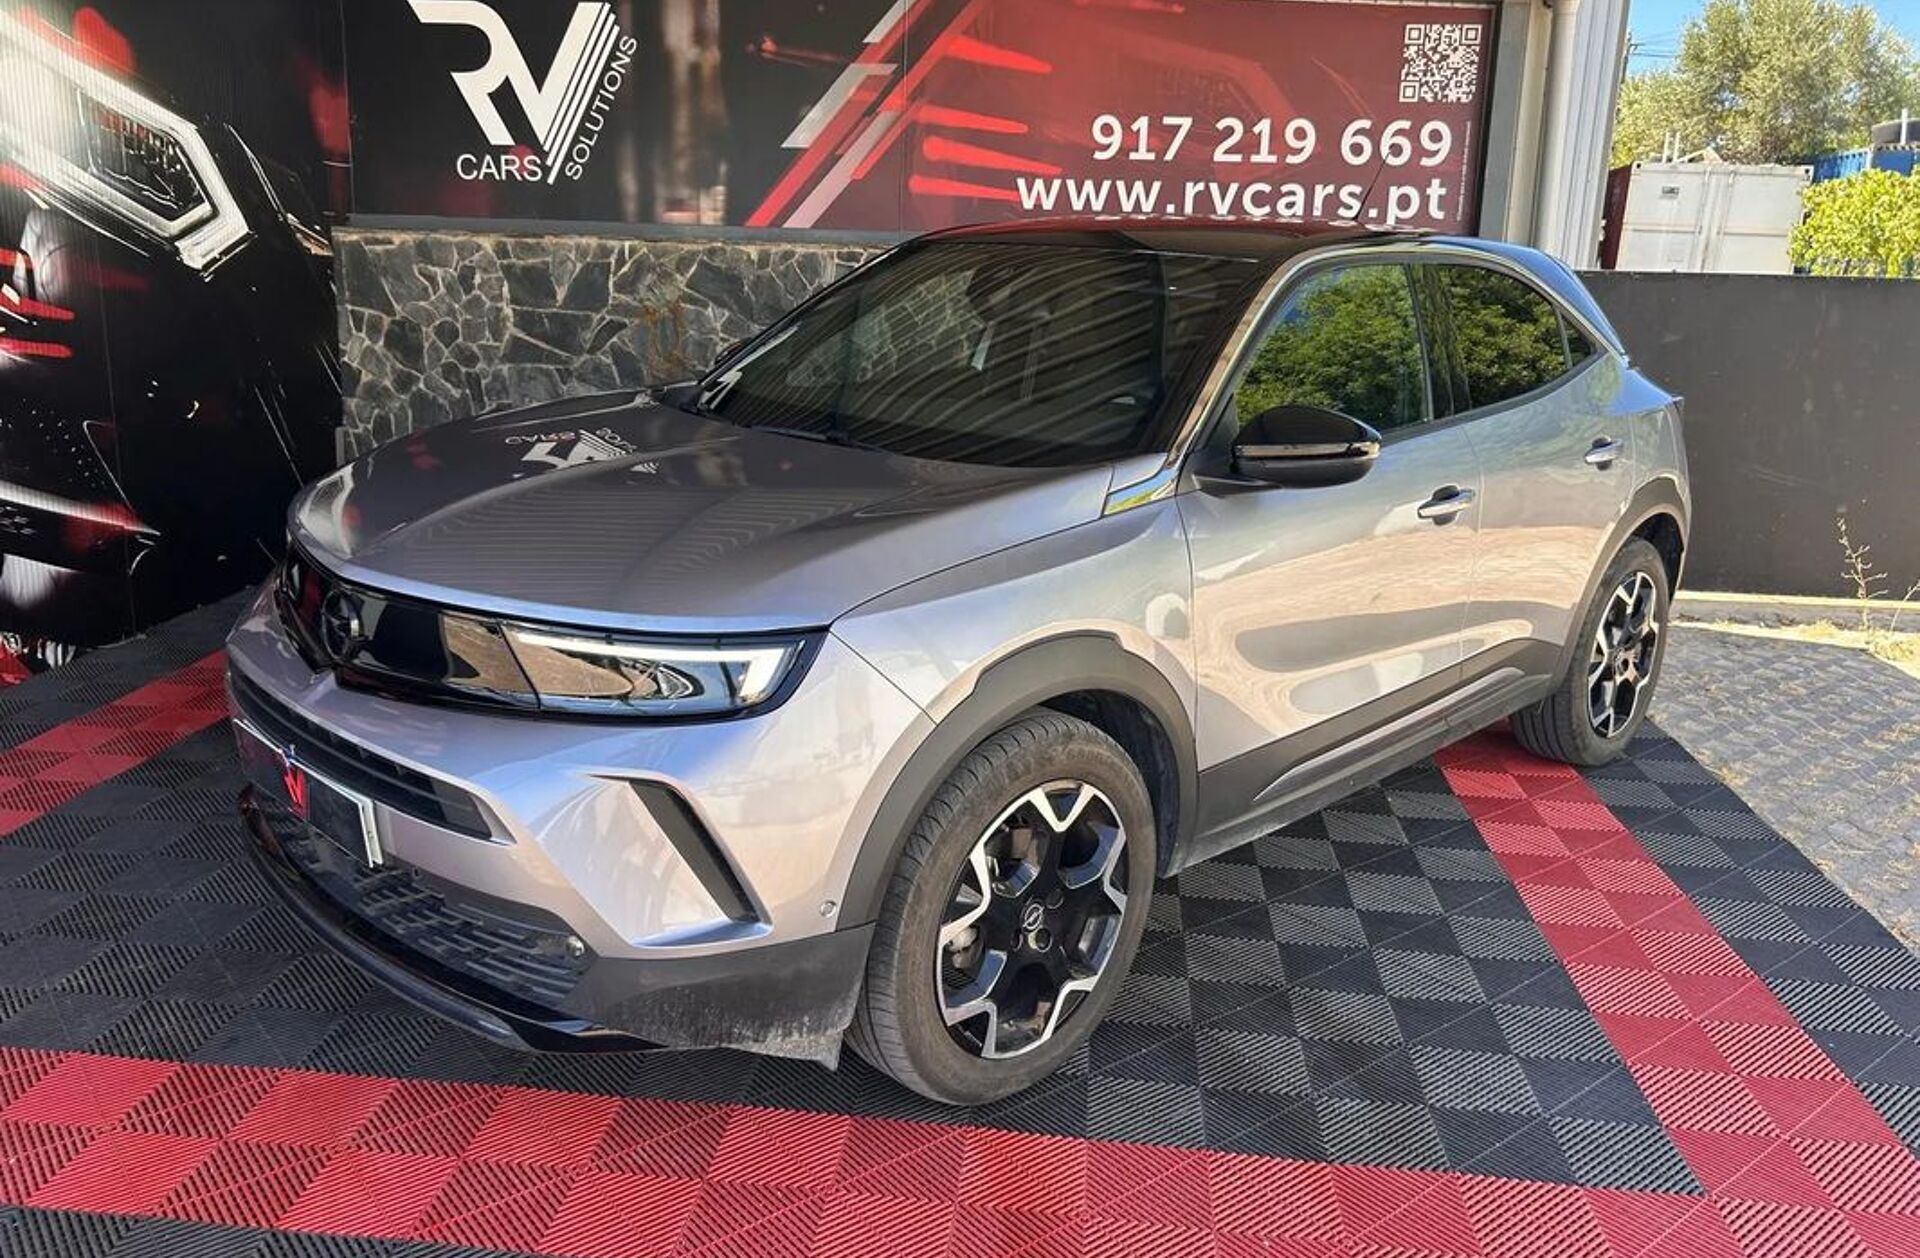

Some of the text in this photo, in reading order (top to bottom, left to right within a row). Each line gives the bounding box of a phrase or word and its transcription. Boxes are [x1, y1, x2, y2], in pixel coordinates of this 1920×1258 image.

[407, 0, 612, 150] RV
[565, 35, 638, 181] SOLUTIONS
[456, 153, 543, 182] CARS
[1091, 114, 1453, 168] 917 219 669
[1016, 176, 1447, 225] www.rvcars.pt
